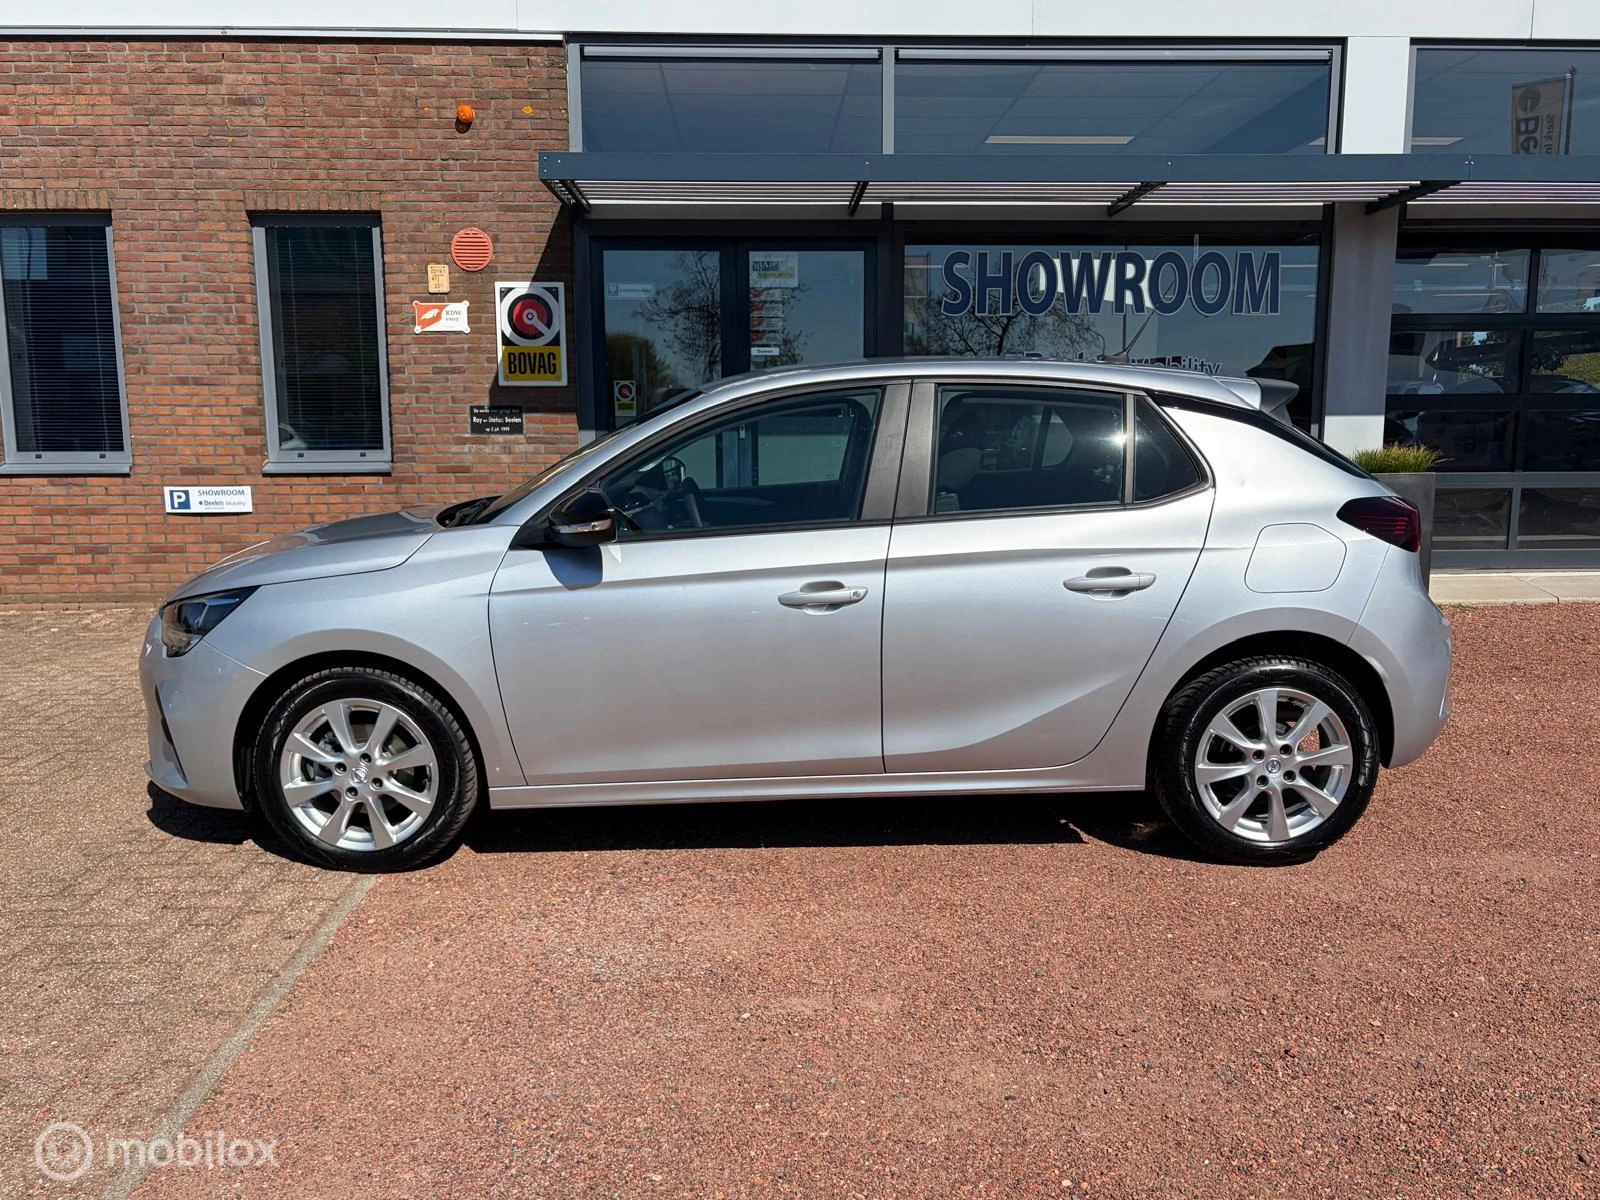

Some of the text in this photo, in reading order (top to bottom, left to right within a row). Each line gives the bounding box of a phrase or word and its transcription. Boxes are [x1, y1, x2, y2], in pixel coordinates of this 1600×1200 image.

[941, 250, 1281, 316] SHOWROOM
[508, 352, 556, 375] BOVAG
[172, 491, 186, 509] P
